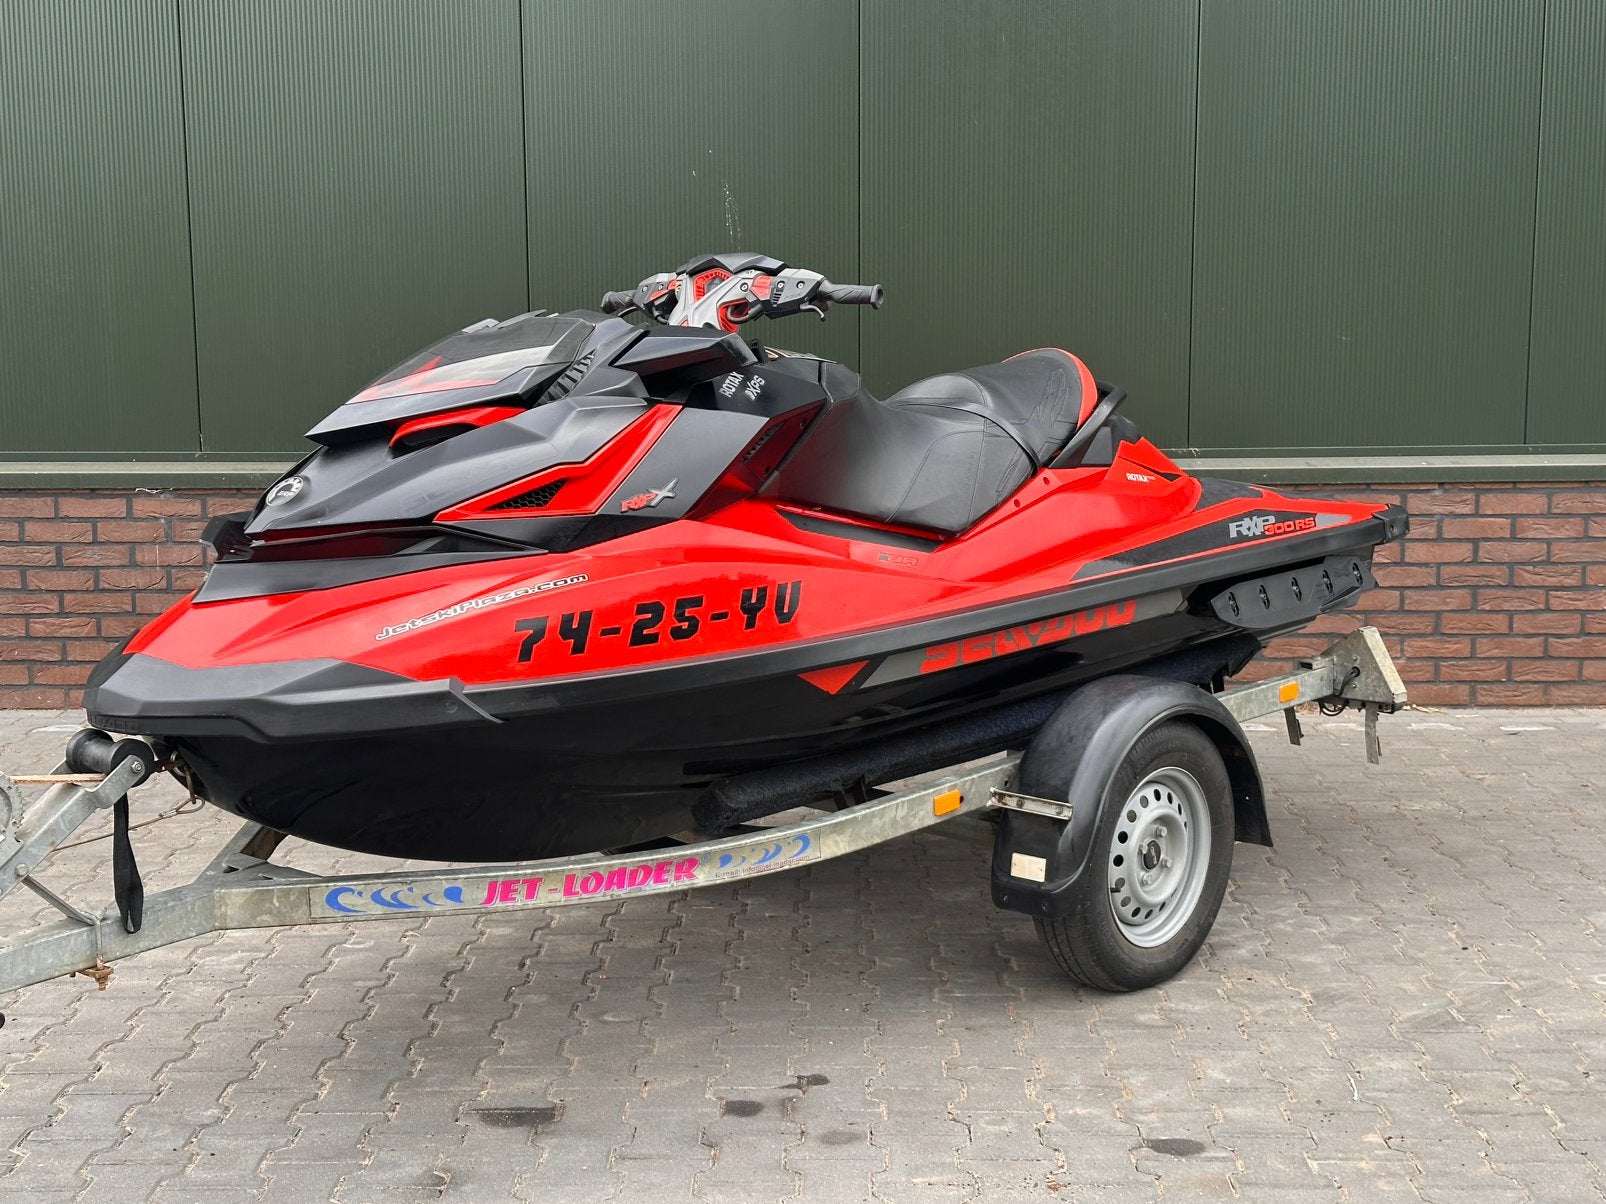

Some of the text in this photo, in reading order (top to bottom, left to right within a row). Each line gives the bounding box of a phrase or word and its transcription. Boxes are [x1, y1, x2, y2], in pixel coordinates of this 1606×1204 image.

[719, 371, 744, 398] ROTAX
[1228, 515, 1276, 538] RXP
[376, 573, 589, 640] JetskiPlaza.com
